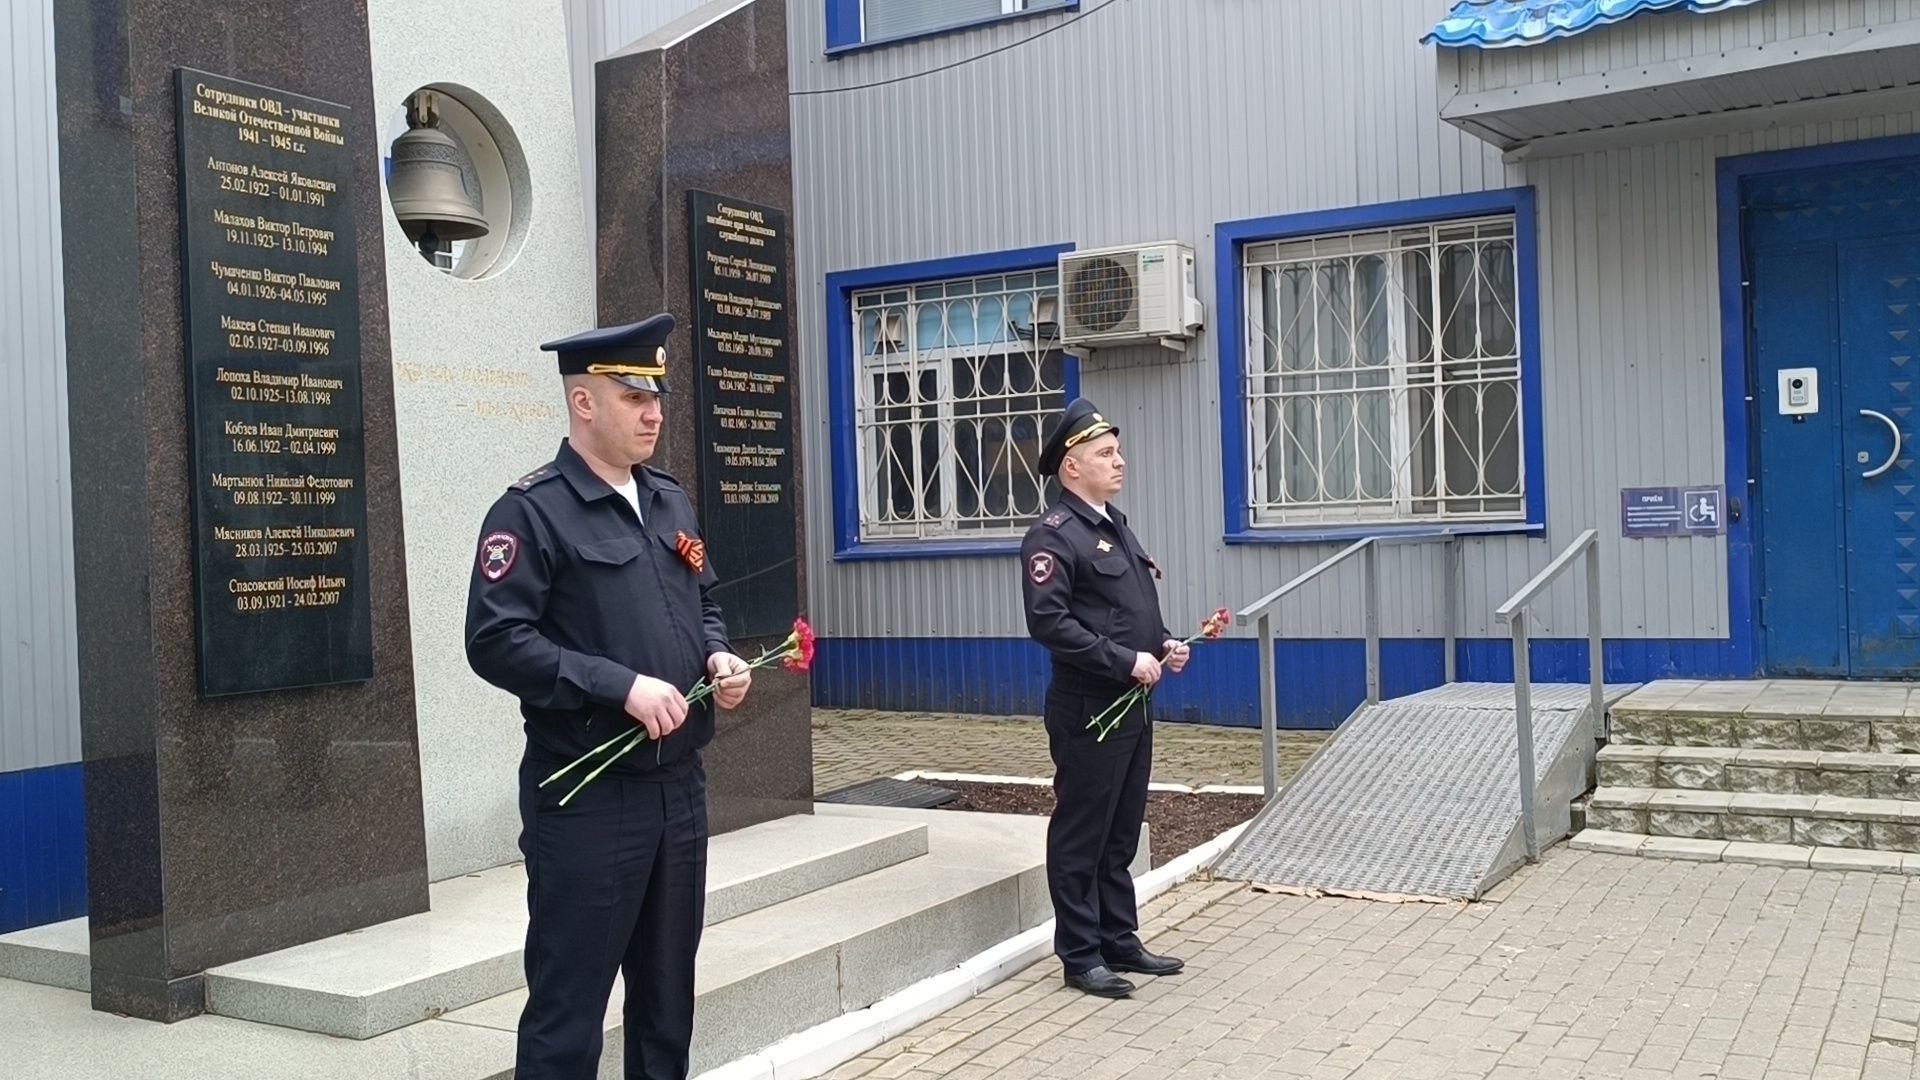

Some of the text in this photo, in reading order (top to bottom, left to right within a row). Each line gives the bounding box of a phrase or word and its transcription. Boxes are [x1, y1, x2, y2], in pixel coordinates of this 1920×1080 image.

[197, 83, 257, 109] Сотрудники
[260, 98, 282, 116] ОВД
[292, 108, 340, 128] участники
[194, 100, 344, 146] Великой Отечественной Войны
[239, 128, 259, 144] 1941
[270, 134, 291, 150] 1945
[208, 156, 336, 192] Антонов Алексей Яковлевич
[221, 175, 270, 197] 25.02.1922
[280, 187, 325, 207] 01.01.1991
[214, 209, 334, 241] Малахов Виктор Петрович
[283, 238, 328, 256] 13.10.1994
[211, 261, 341, 291] Чумаченко Виктор Павлович
[221, 315, 335, 340] Макеев Степан Иванович
[253, 371, 299, 390] Владимир
[301, 374, 343, 389] Иванович
[225, 421, 339, 440] Кобзев Иван Дмитриевич
[233, 439, 280, 453] 16.06.1922
[290, 441, 336, 454] 02.04.1999
[212, 473, 353, 490] Мартынюк Николай Федотович
[290, 492, 335, 505] 30.11.1999
[215, 526, 355, 540] Мясников Алексей Николаевич
[292, 542, 337, 555] 25.03.2007
[229, 576, 345, 593] Спасовский Иосиф Ильич
[238, 595, 286, 610] 03.09.1921
[294, 592, 340, 606] 24.02.2007
